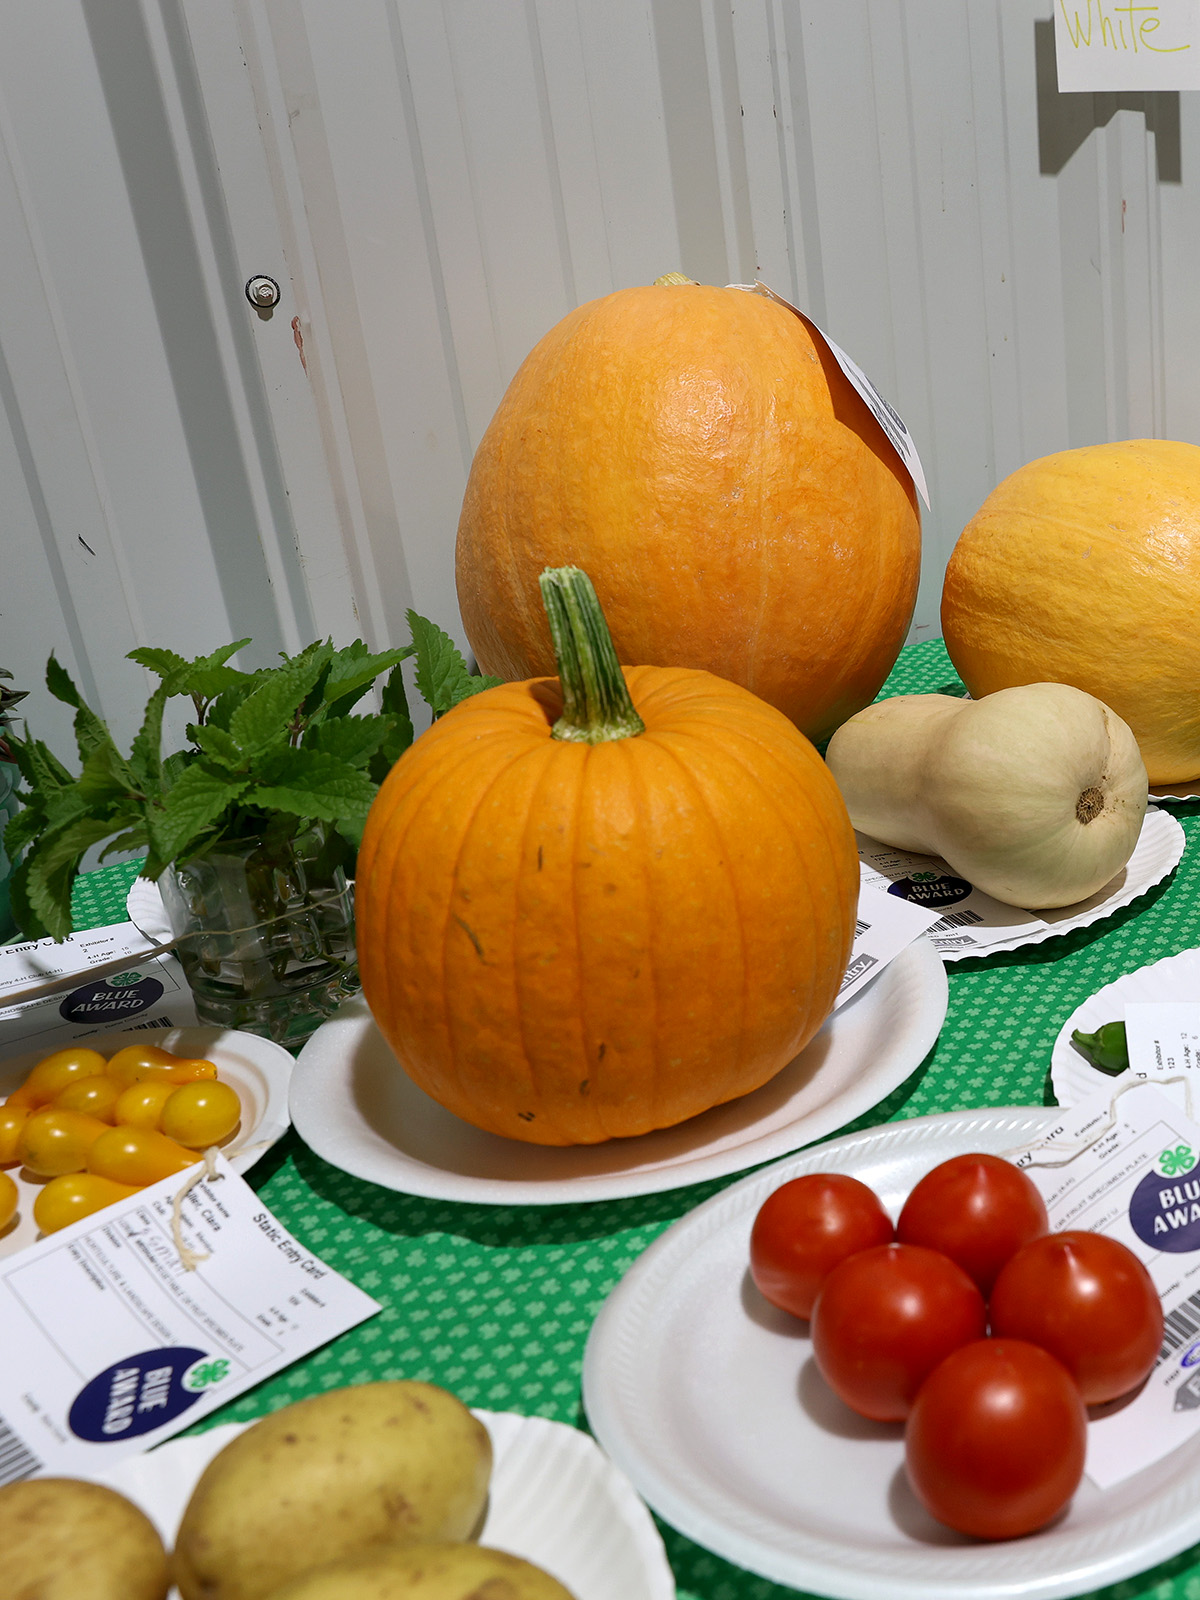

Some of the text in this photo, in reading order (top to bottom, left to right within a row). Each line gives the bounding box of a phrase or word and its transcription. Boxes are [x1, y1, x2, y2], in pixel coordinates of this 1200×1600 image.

[1060, 0, 1190, 53] White
[906, 888, 965, 901] AWARD
[912, 882, 950, 893] BLUE
[843, 961, 867, 983] ntry
[92, 990, 139, 1001] BLUE
[1, 1001, 38, 1015] ANDSCAPE
[72, 999, 143, 1013] AWARD
[1155, 1045, 1163, 1070] Exhibitor
[1167, 1057, 1175, 1069] 123
[253, 1213, 325, 1279] Static Entry Card
[137, 1365, 173, 1415] BLUE
[102, 1368, 141, 1435] AWARD
